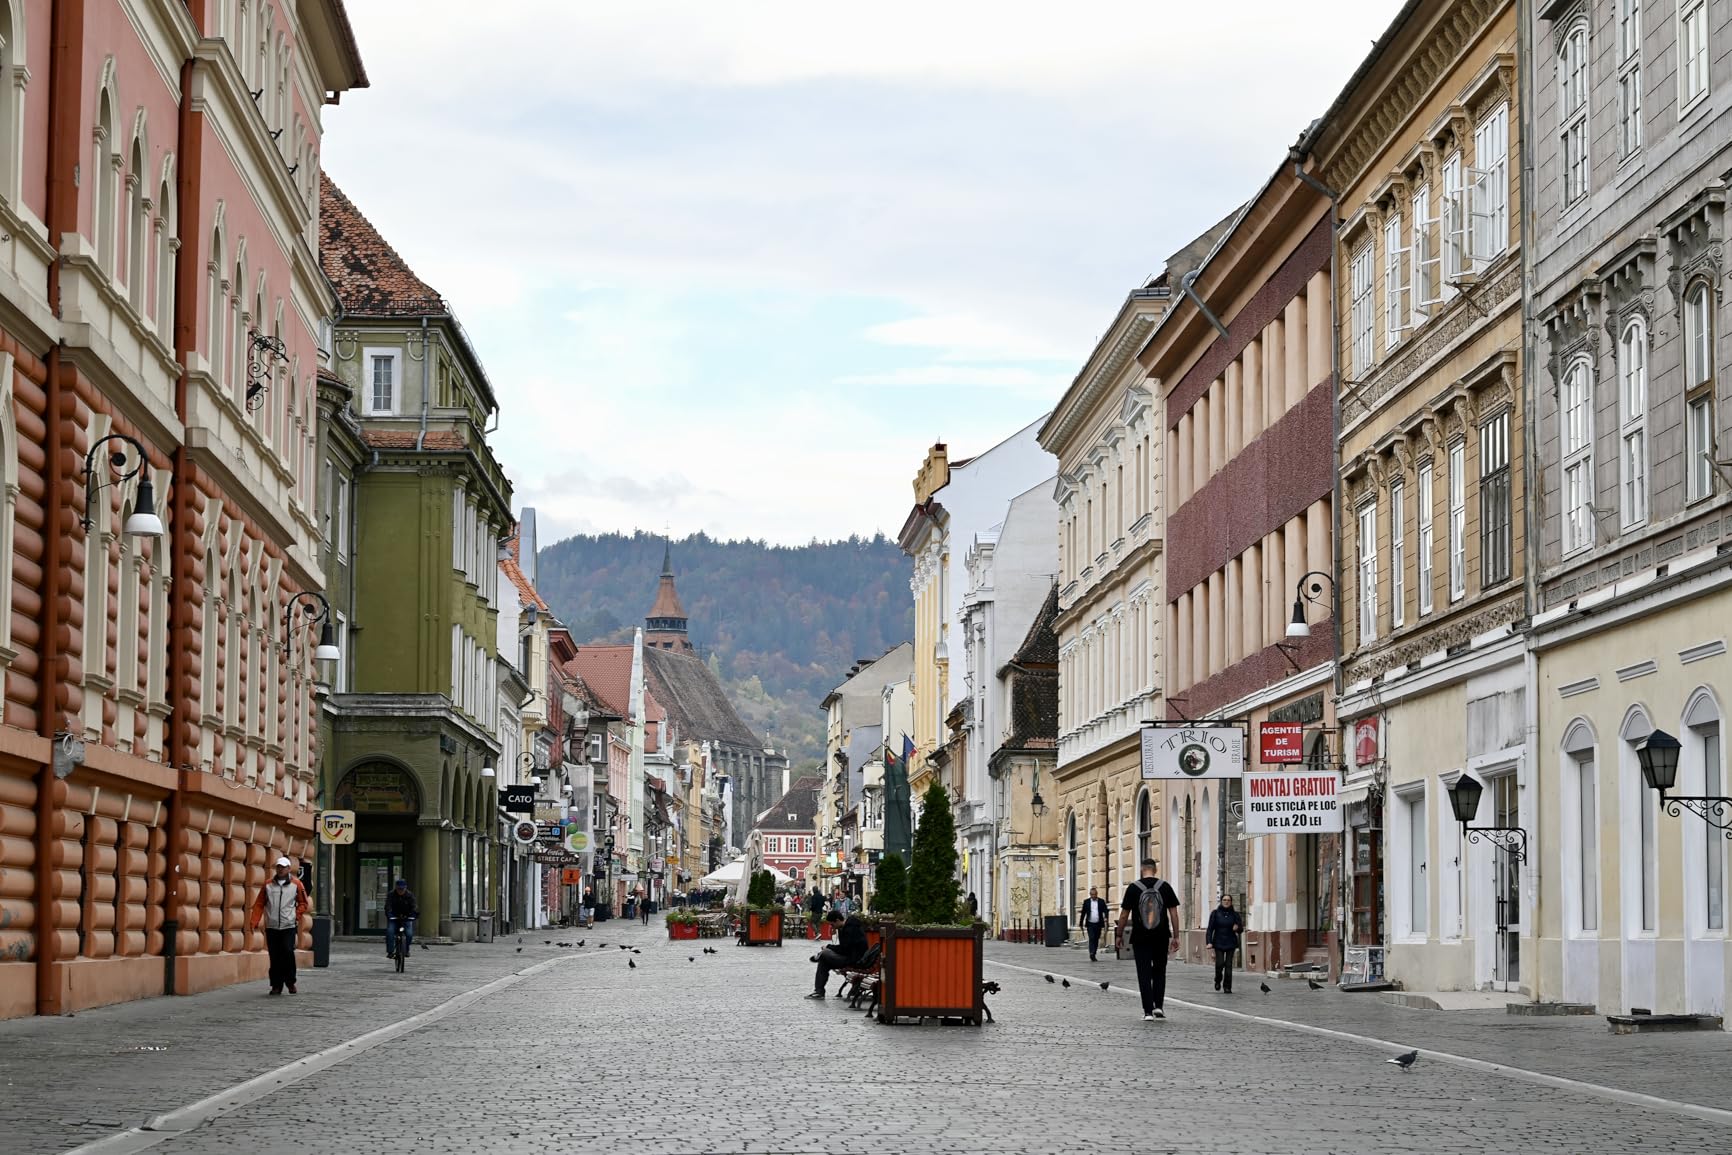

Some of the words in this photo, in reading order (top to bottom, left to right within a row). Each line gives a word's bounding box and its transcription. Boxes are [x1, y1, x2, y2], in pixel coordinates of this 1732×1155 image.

[1160, 729, 1227, 754] TRIO
[1144, 736, 1154, 774] RESTAURANT
[1231, 739, 1241, 764] BERARIE
[1264, 749, 1300, 757] TURISM
[1250, 778, 1291, 798] MONTAJ
[1293, 777, 1336, 796] GRATUIT
[508, 795, 532, 803] CATO
[1251, 801, 1274, 812] FOLIE
[1275, 800, 1306, 811] STICLĂ
[1308, 801, 1319, 811] PE
[1320, 800, 1337, 810] LOC
[327, 820, 340, 828] BT
[1267, 817, 1278, 827] DE
[1280, 817, 1290, 827] LA
[1292, 813, 1307, 827] 20
[1309, 817, 1322, 826] LEI
